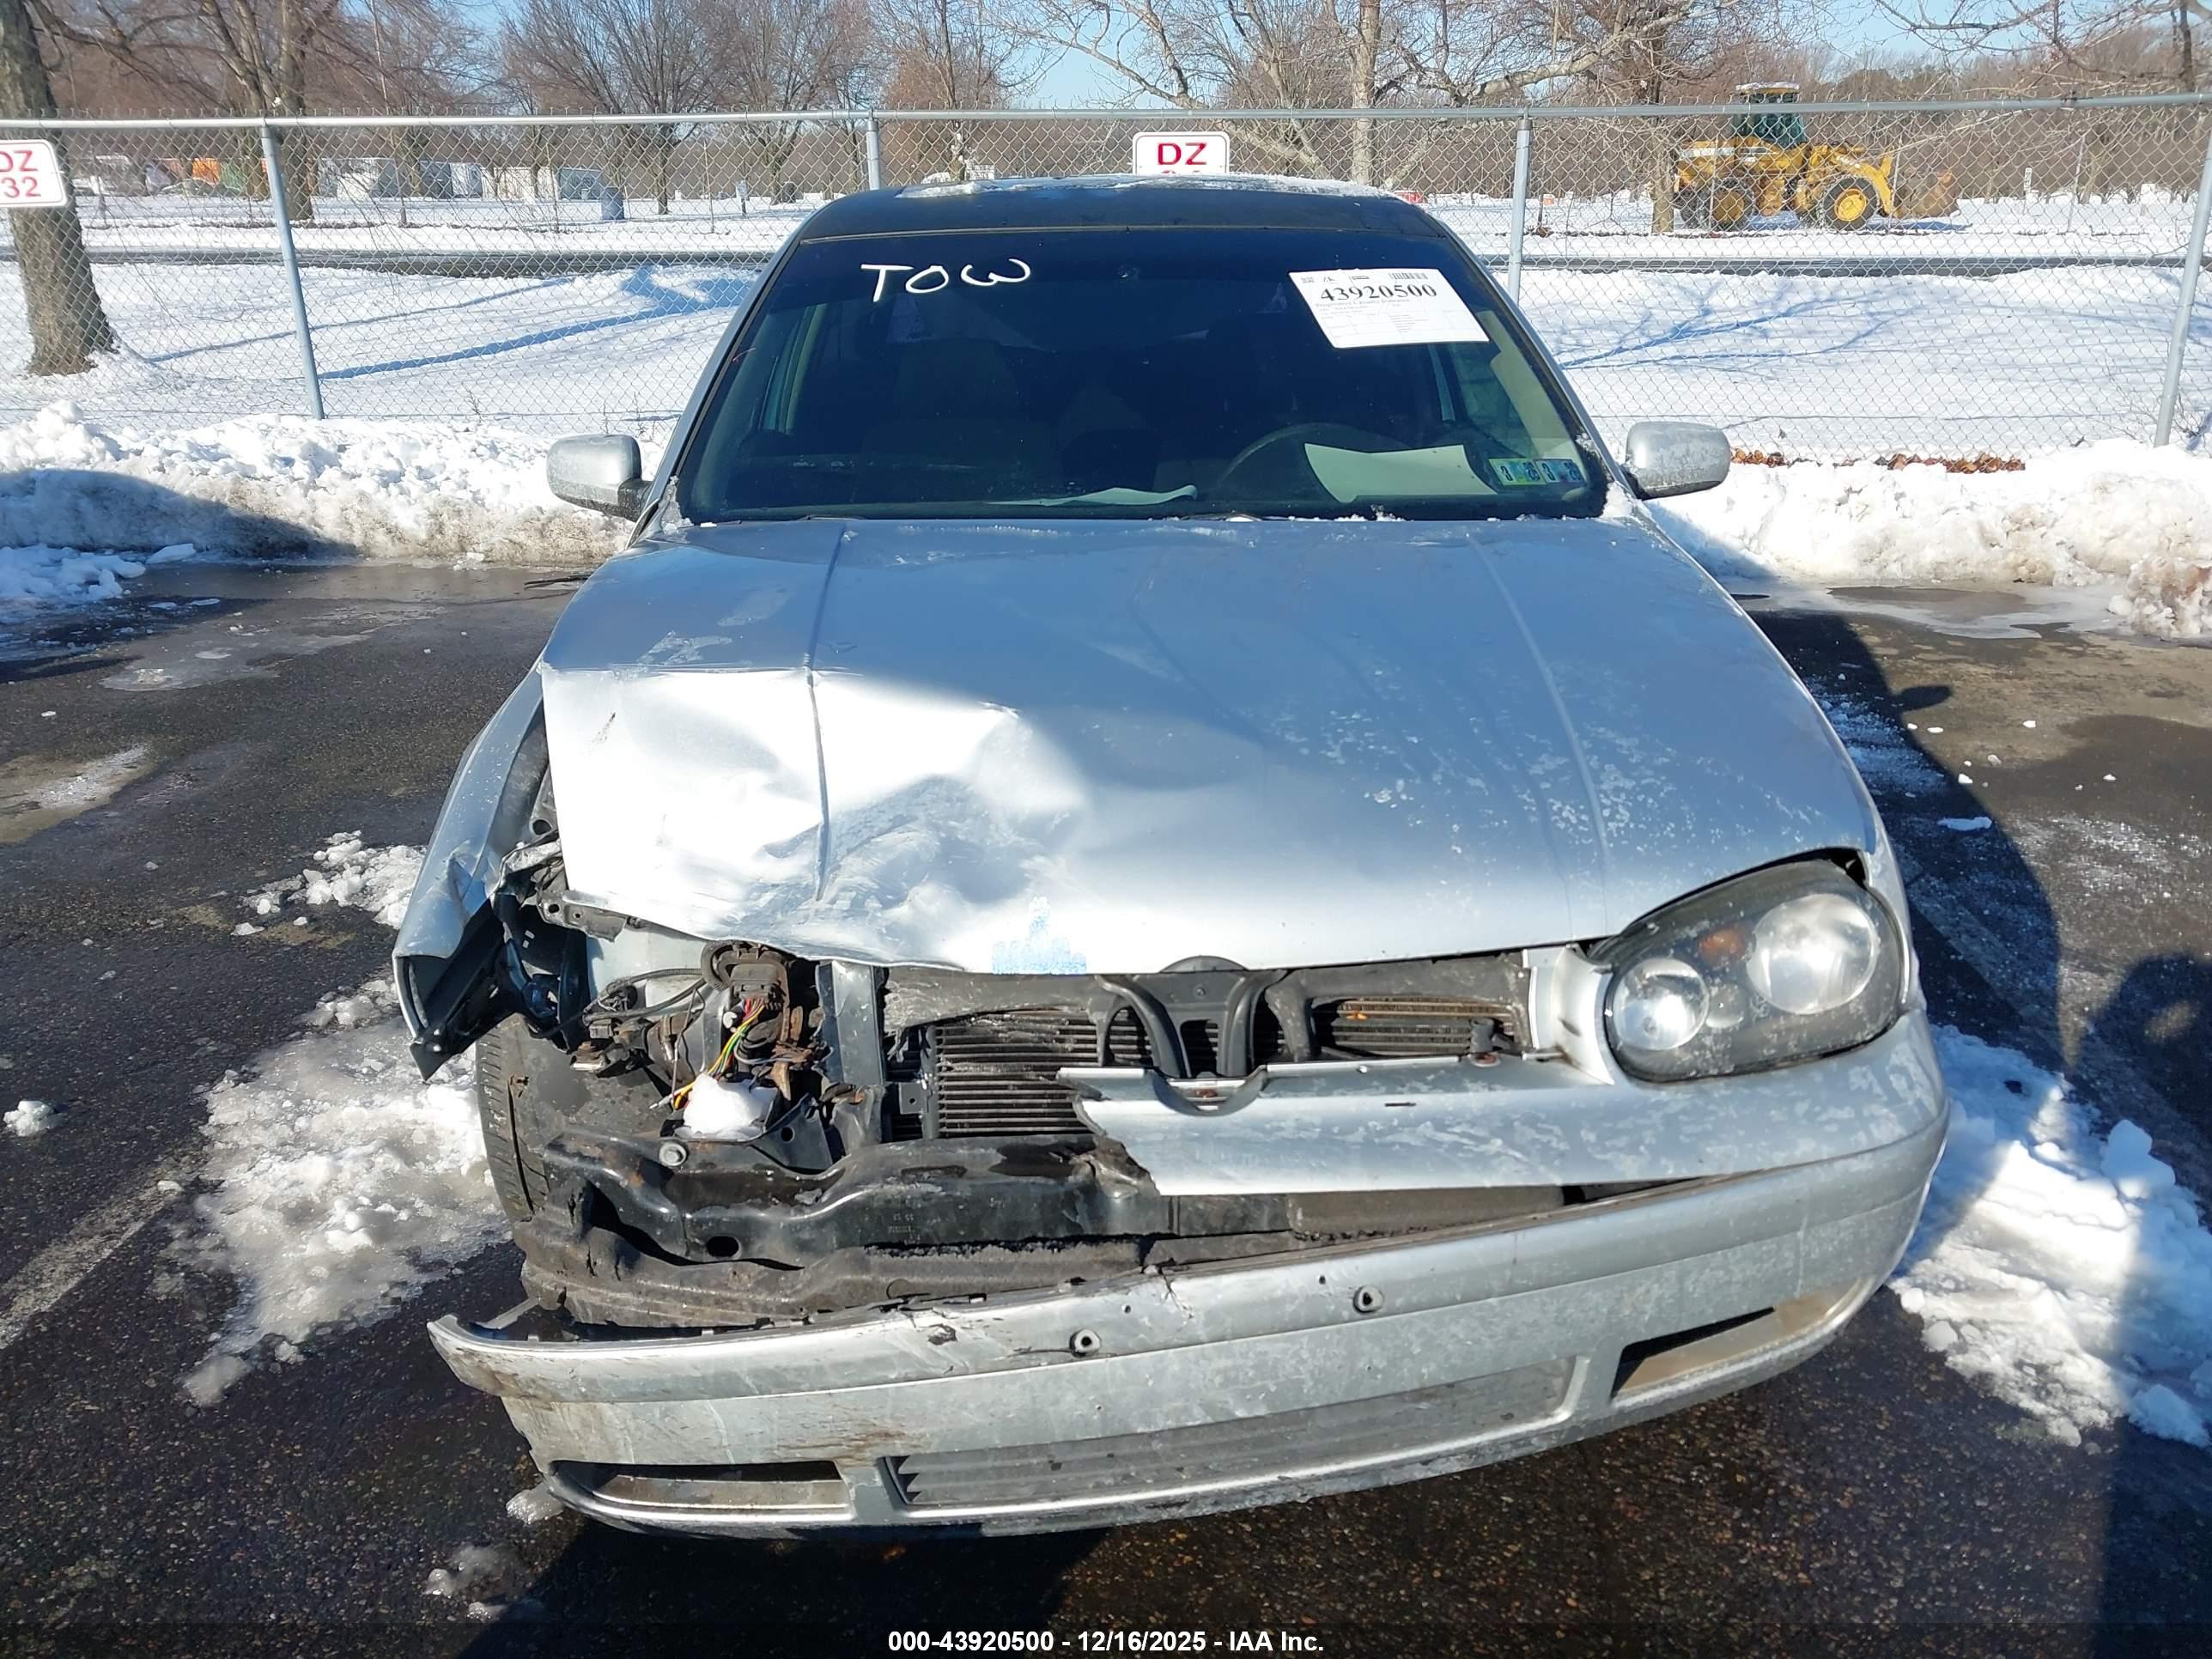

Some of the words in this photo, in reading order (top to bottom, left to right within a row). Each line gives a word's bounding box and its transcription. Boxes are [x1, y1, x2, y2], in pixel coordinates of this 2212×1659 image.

[1158, 143, 1207, 166] DZ
[1, 177, 42, 198] 32
[860, 258, 1031, 302] TOW
[1320, 283, 1437, 301] 43920500
[1500, 465, 1513, 481] 3
[1541, 462, 1556, 481] 3
